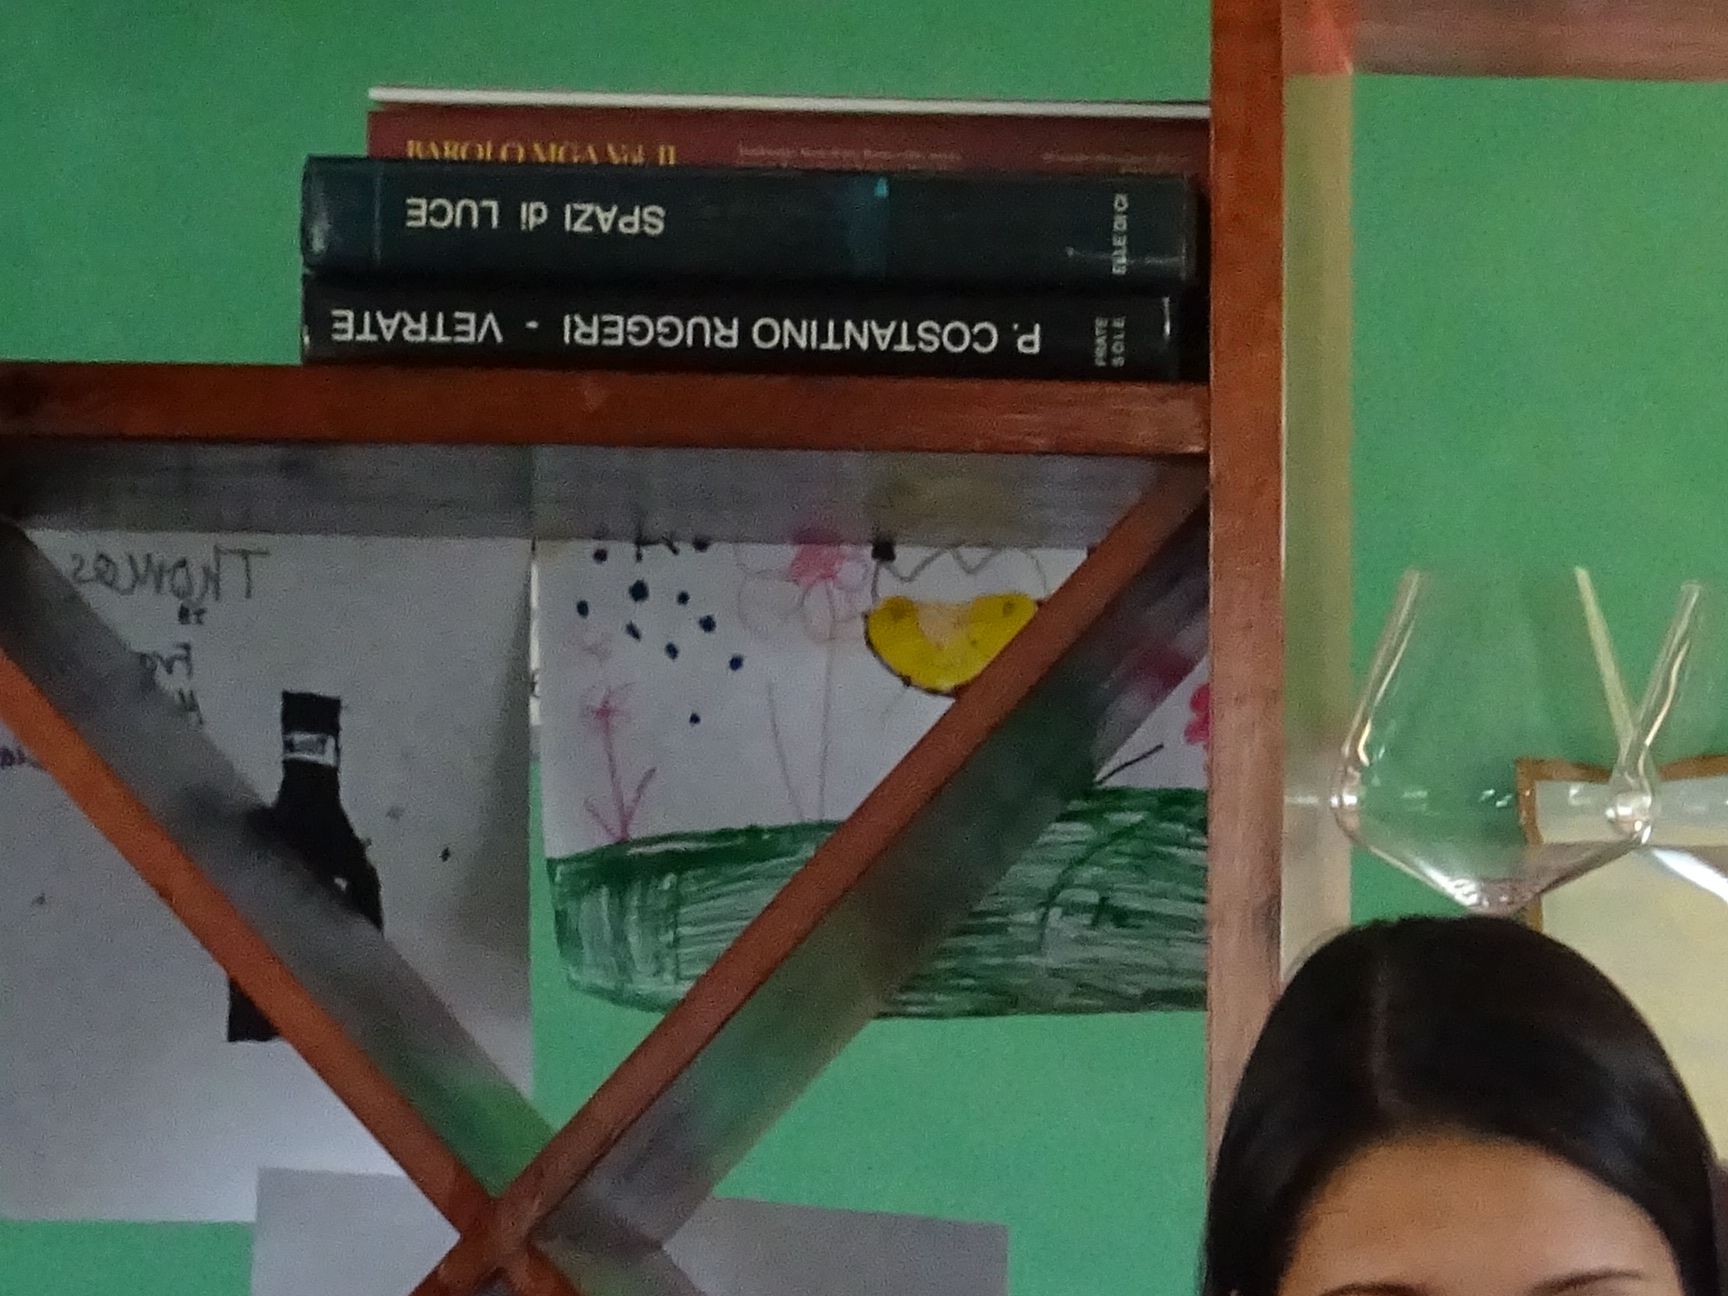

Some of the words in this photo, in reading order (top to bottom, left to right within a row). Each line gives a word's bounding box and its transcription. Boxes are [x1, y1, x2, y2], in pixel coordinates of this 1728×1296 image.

[405, 198, 500, 230] LUCE
[520, 201, 549, 232] di
[564, 203, 666, 237] SPAZI
[331, 308, 504, 344] VETRATE
[563, 313, 740, 349] RUGGERI
[751, 316, 999, 353] COSTANTINO
[1012, 322, 1042, 355] P.
